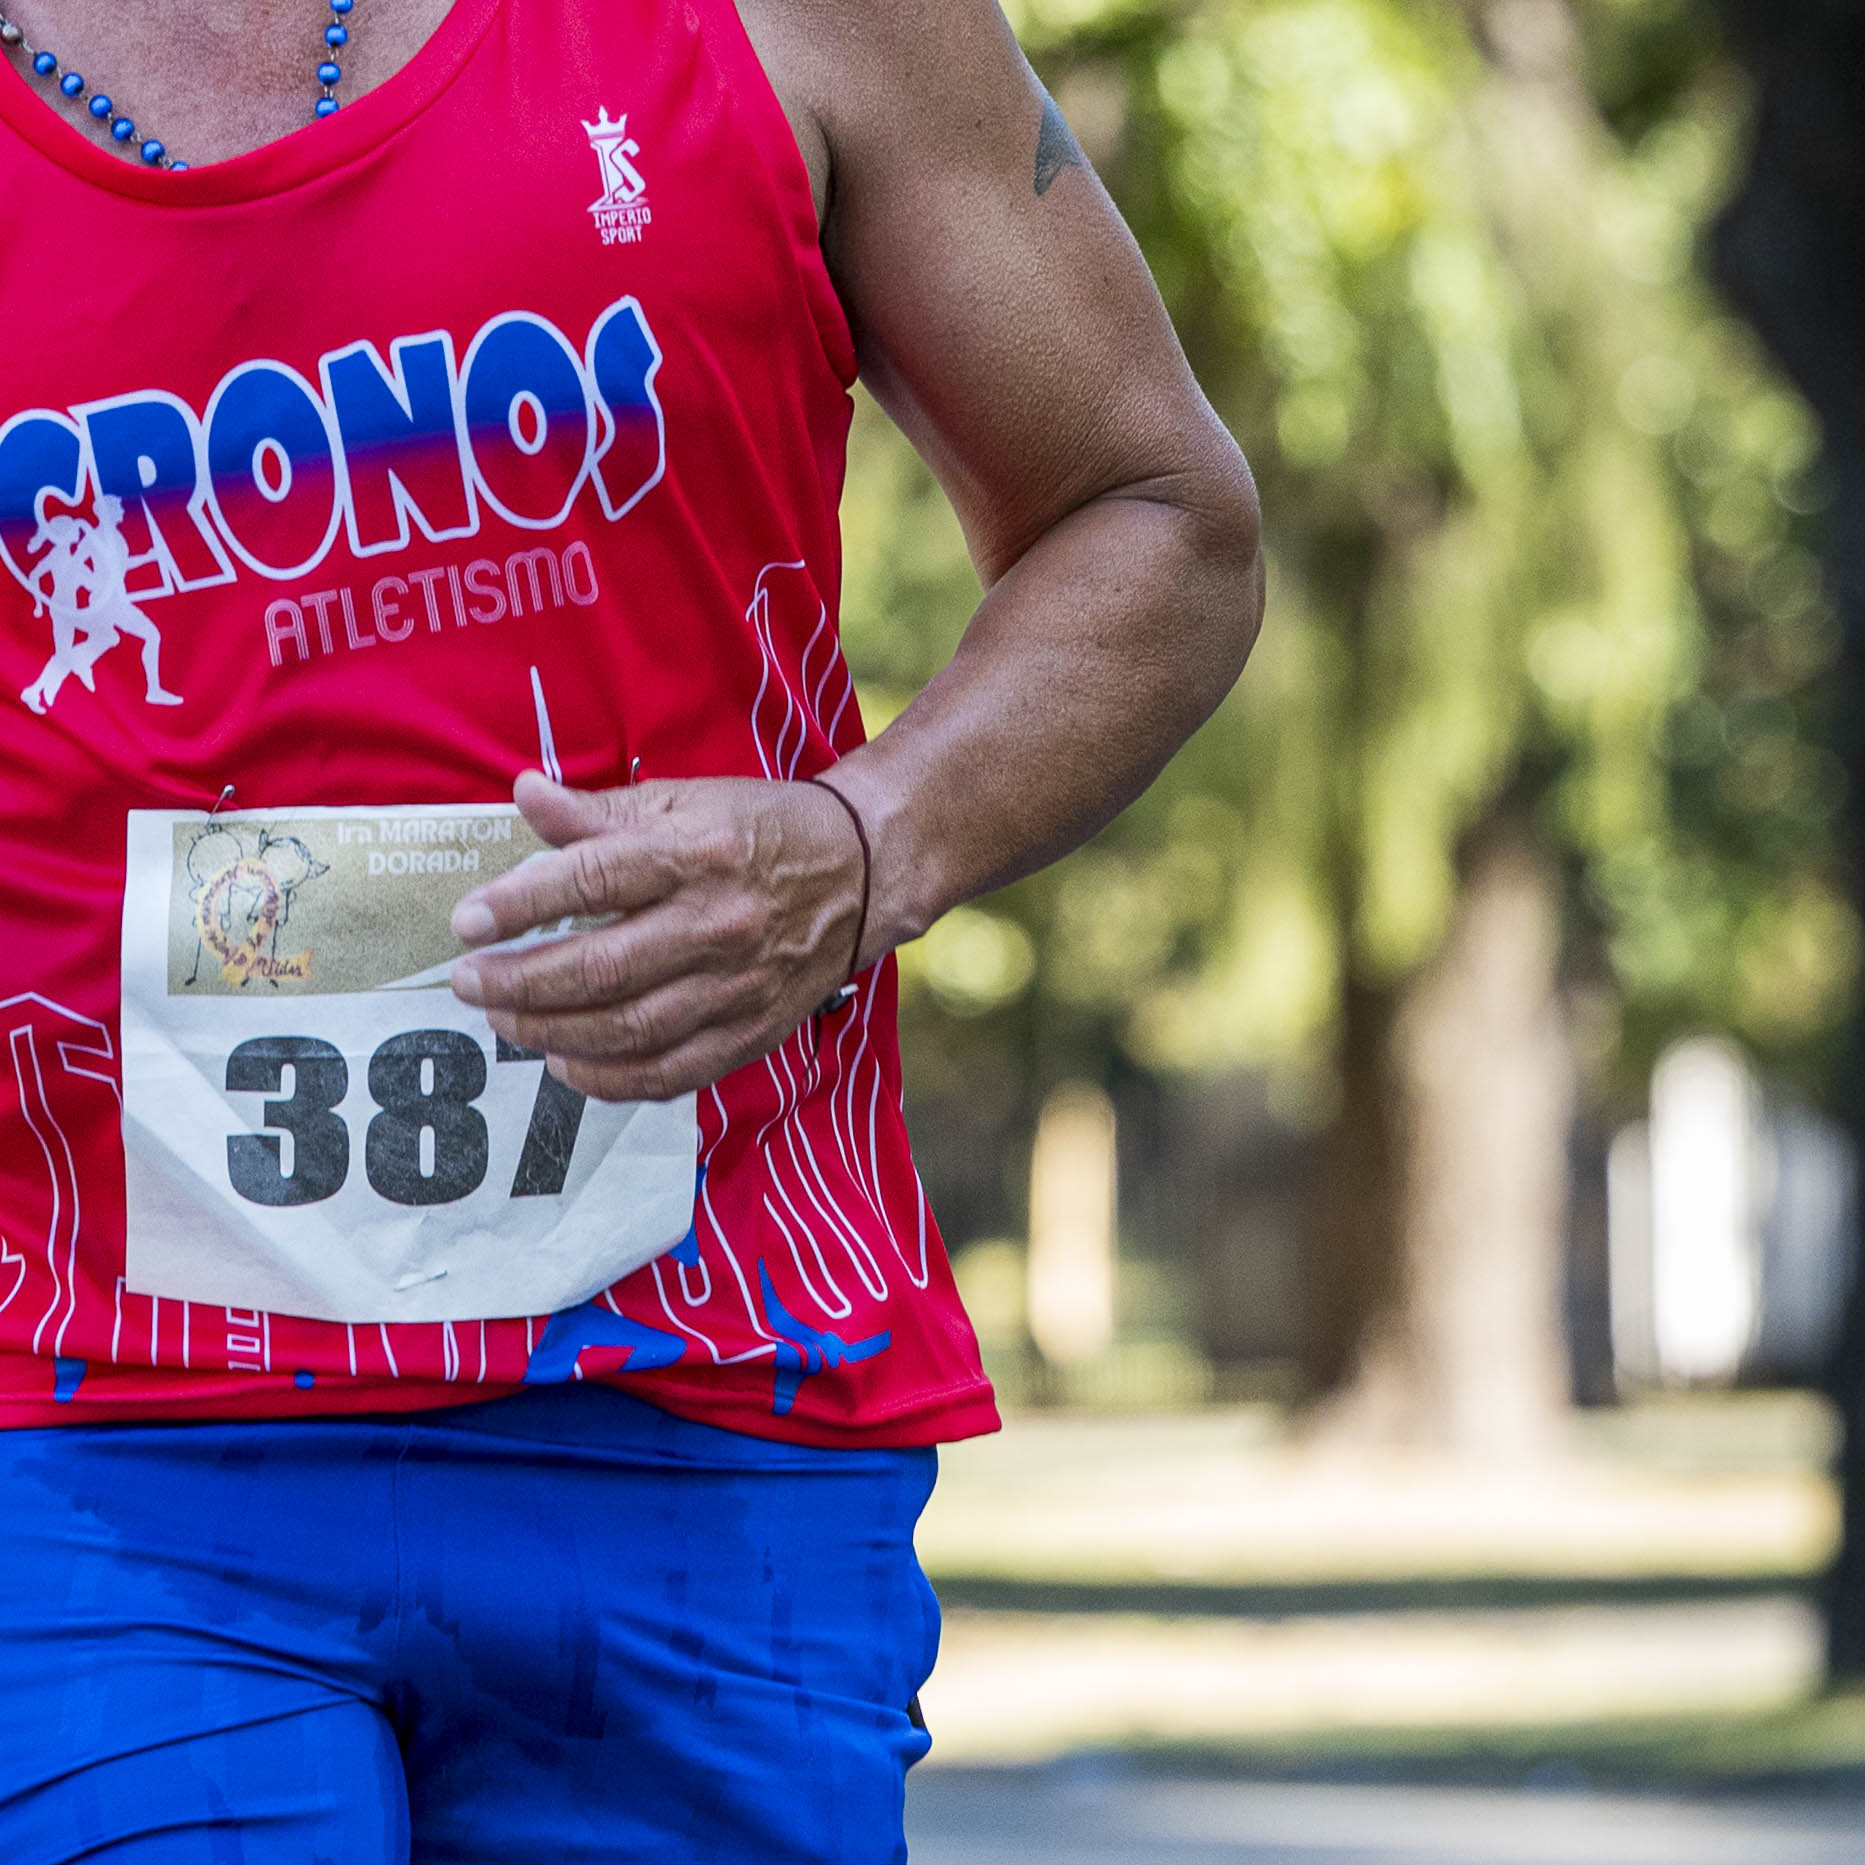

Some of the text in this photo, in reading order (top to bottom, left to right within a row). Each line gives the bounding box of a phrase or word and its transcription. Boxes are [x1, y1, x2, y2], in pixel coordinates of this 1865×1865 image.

[593, 207, 652, 229] IMPERIO
[600, 226, 642, 245] SPORT
[264, 540, 599, 667] ATLETISMO
[379, 818, 512, 842] MARATON
[368, 849, 480, 875] DORADA
[225, 1028, 589, 1208] 387
